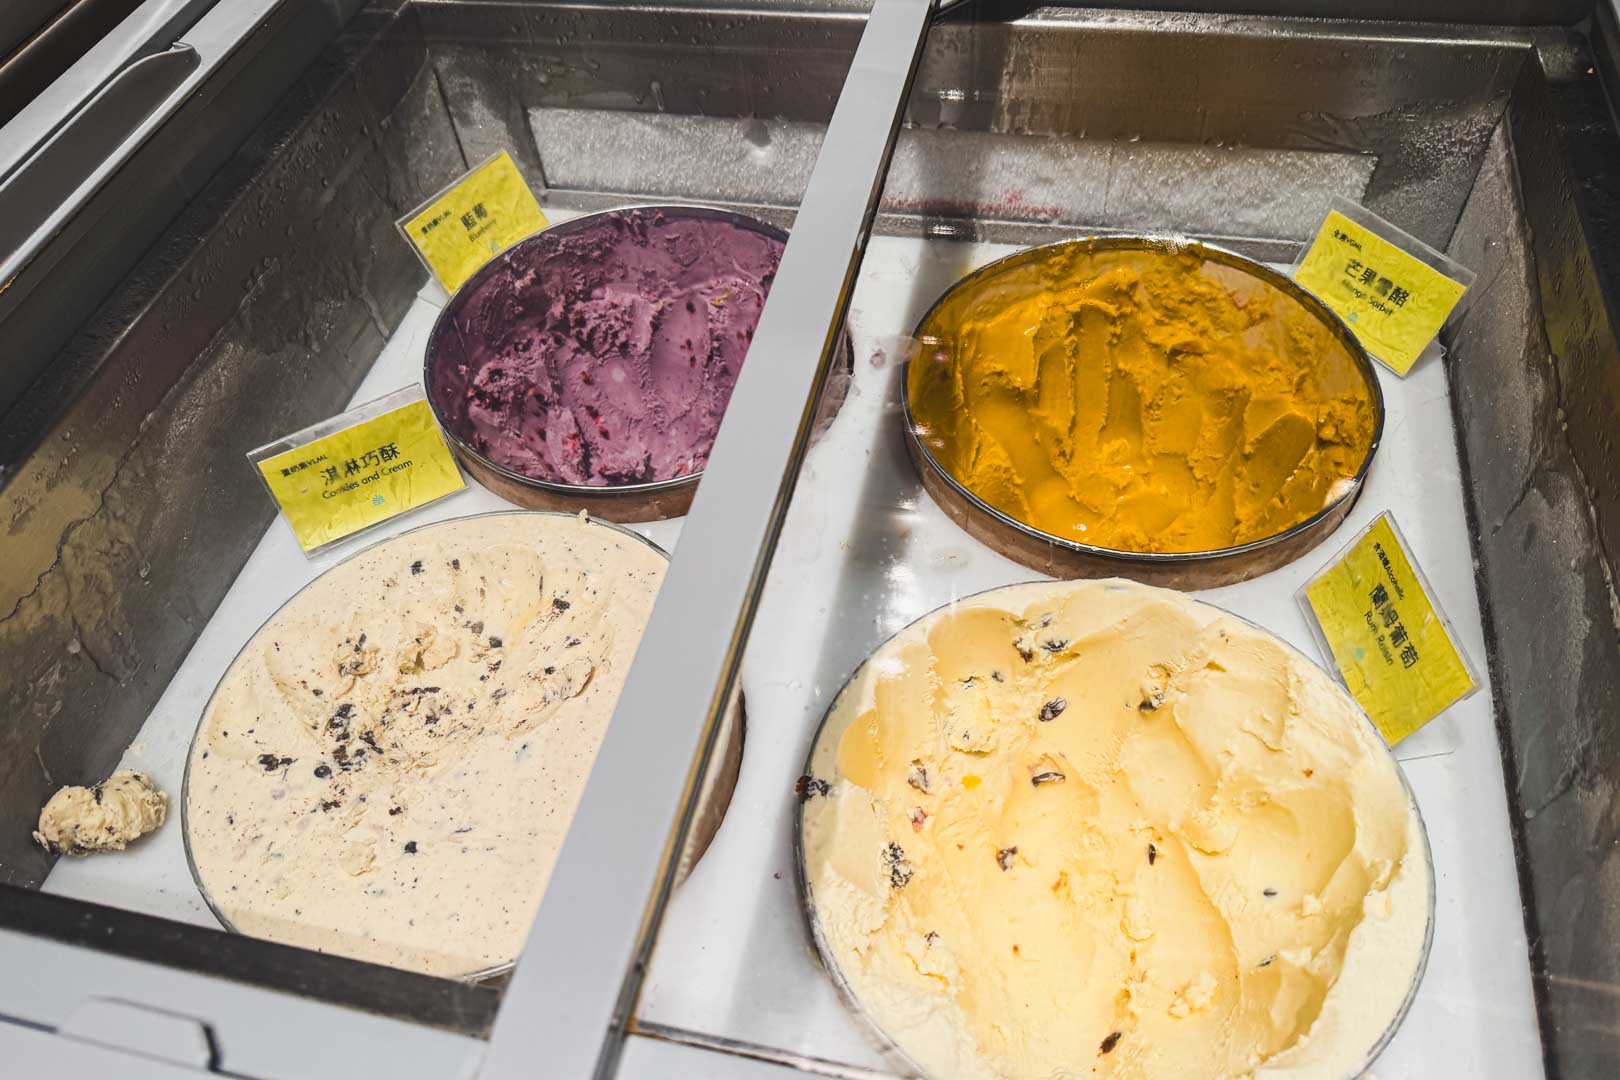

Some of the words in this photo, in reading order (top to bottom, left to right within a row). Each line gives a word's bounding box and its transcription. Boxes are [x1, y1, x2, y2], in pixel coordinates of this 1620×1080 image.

[361, 472, 380, 486] and
[381, 459, 413, 477] Cream
[1364, 610, 1379, 634] Rum
